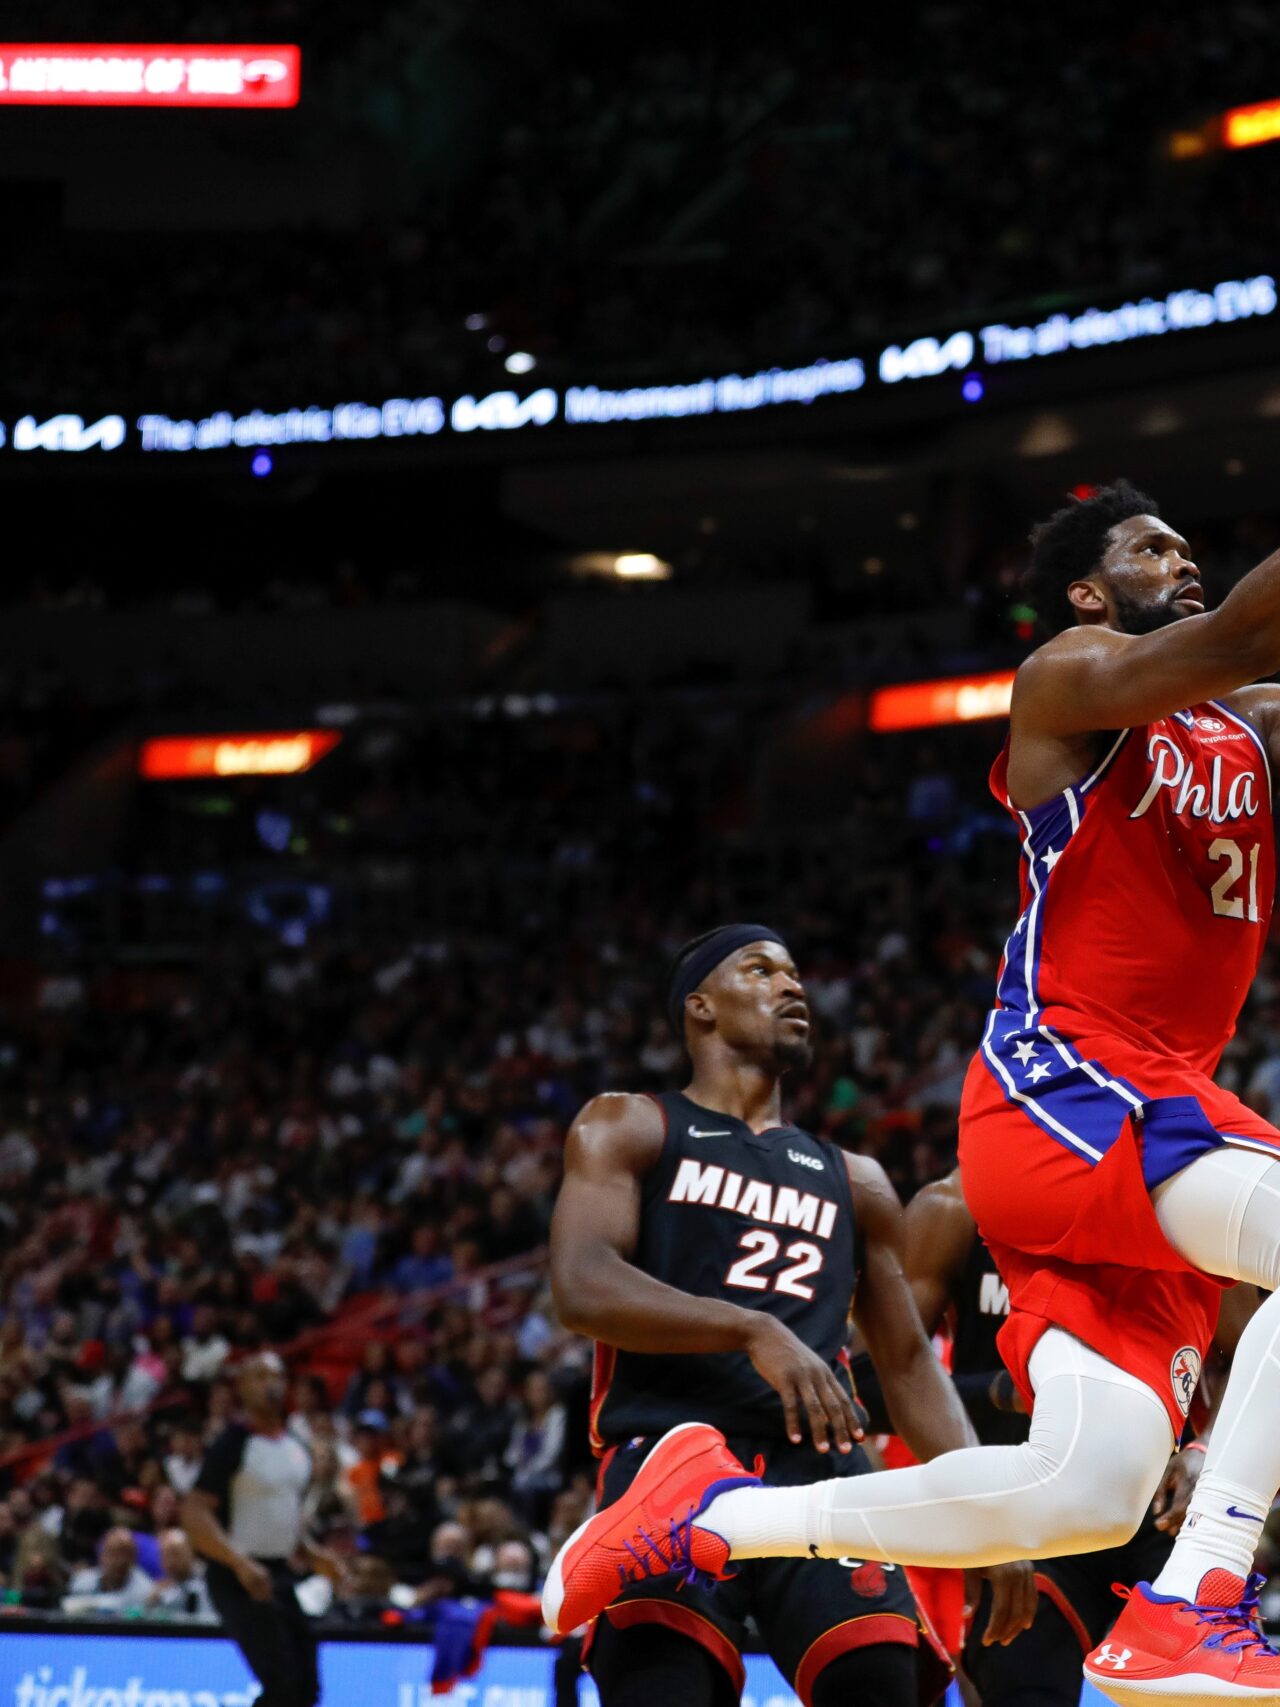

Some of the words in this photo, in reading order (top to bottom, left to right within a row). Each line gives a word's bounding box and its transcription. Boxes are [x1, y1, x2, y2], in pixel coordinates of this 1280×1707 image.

[980, 324, 1034, 364] The
[1034, 298, 1167, 356] all-electric
[1167, 289, 1214, 330] Kia
[1214, 275, 1278, 322] EV6
[138, 414, 195, 452] The
[332, 401, 382, 440] Kia
[1199, 732, 1247, 744] crypto.com
[1208, 838, 1261, 923] 21
[787, 1148, 825, 1171] UKG
[667, 1158, 839, 1240] MIAMI
[723, 1228, 824, 1302] 22
